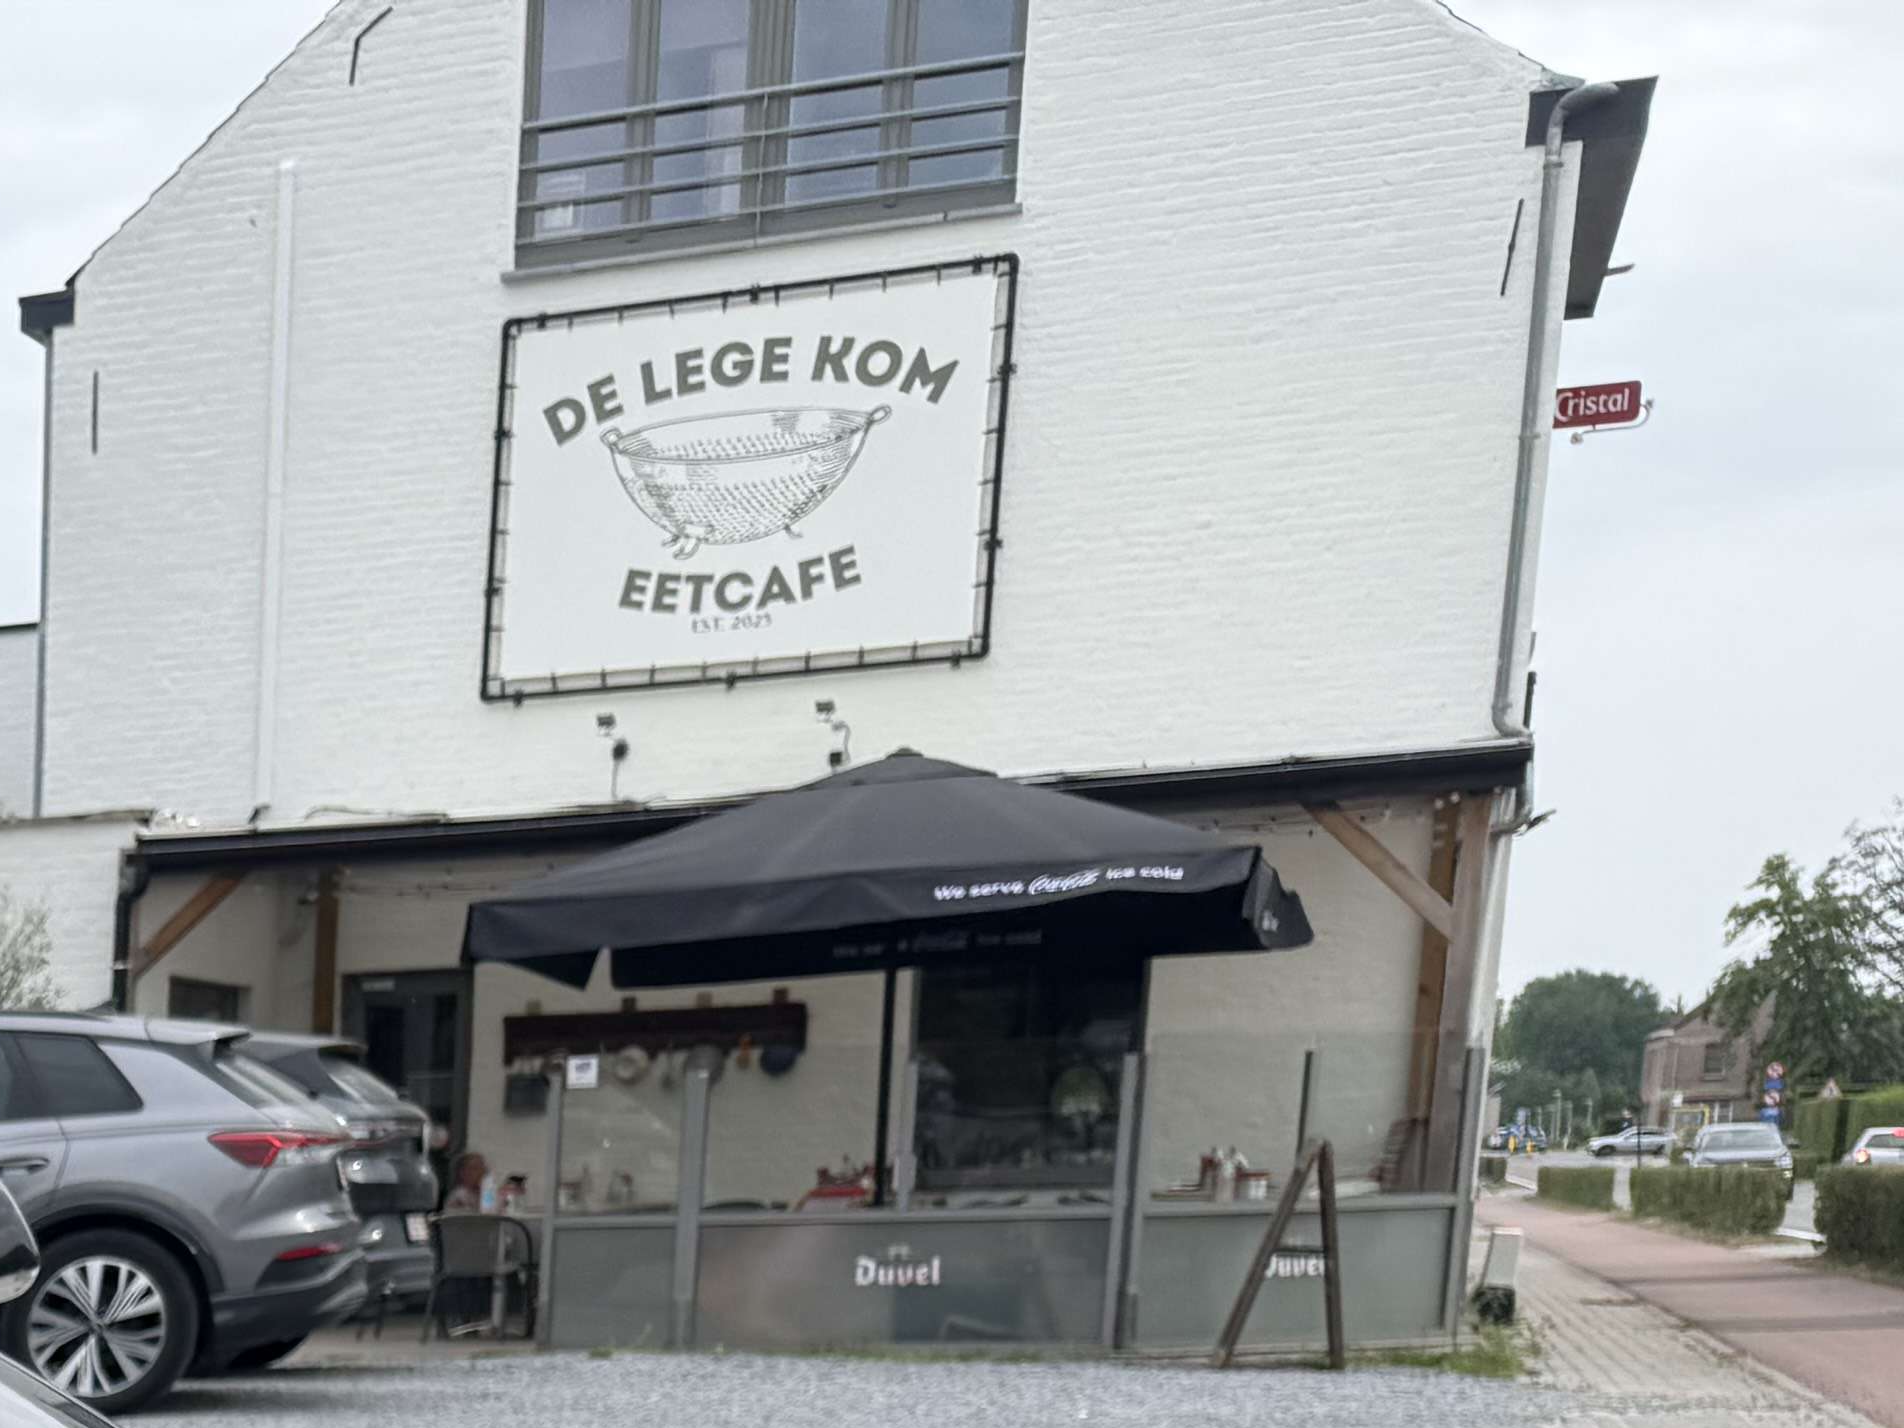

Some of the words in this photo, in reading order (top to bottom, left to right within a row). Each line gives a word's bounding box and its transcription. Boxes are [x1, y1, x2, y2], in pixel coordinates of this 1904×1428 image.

[543, 373, 625, 446] DE
[639, 336, 794, 406] LEGE
[810, 335, 960, 404] KOM
[1554, 387, 1630, 422] Cristal
[617, 545, 863, 615] EETCAFE
[969, 879, 1025, 898] serve
[854, 1254, 941, 1287] Duvel
